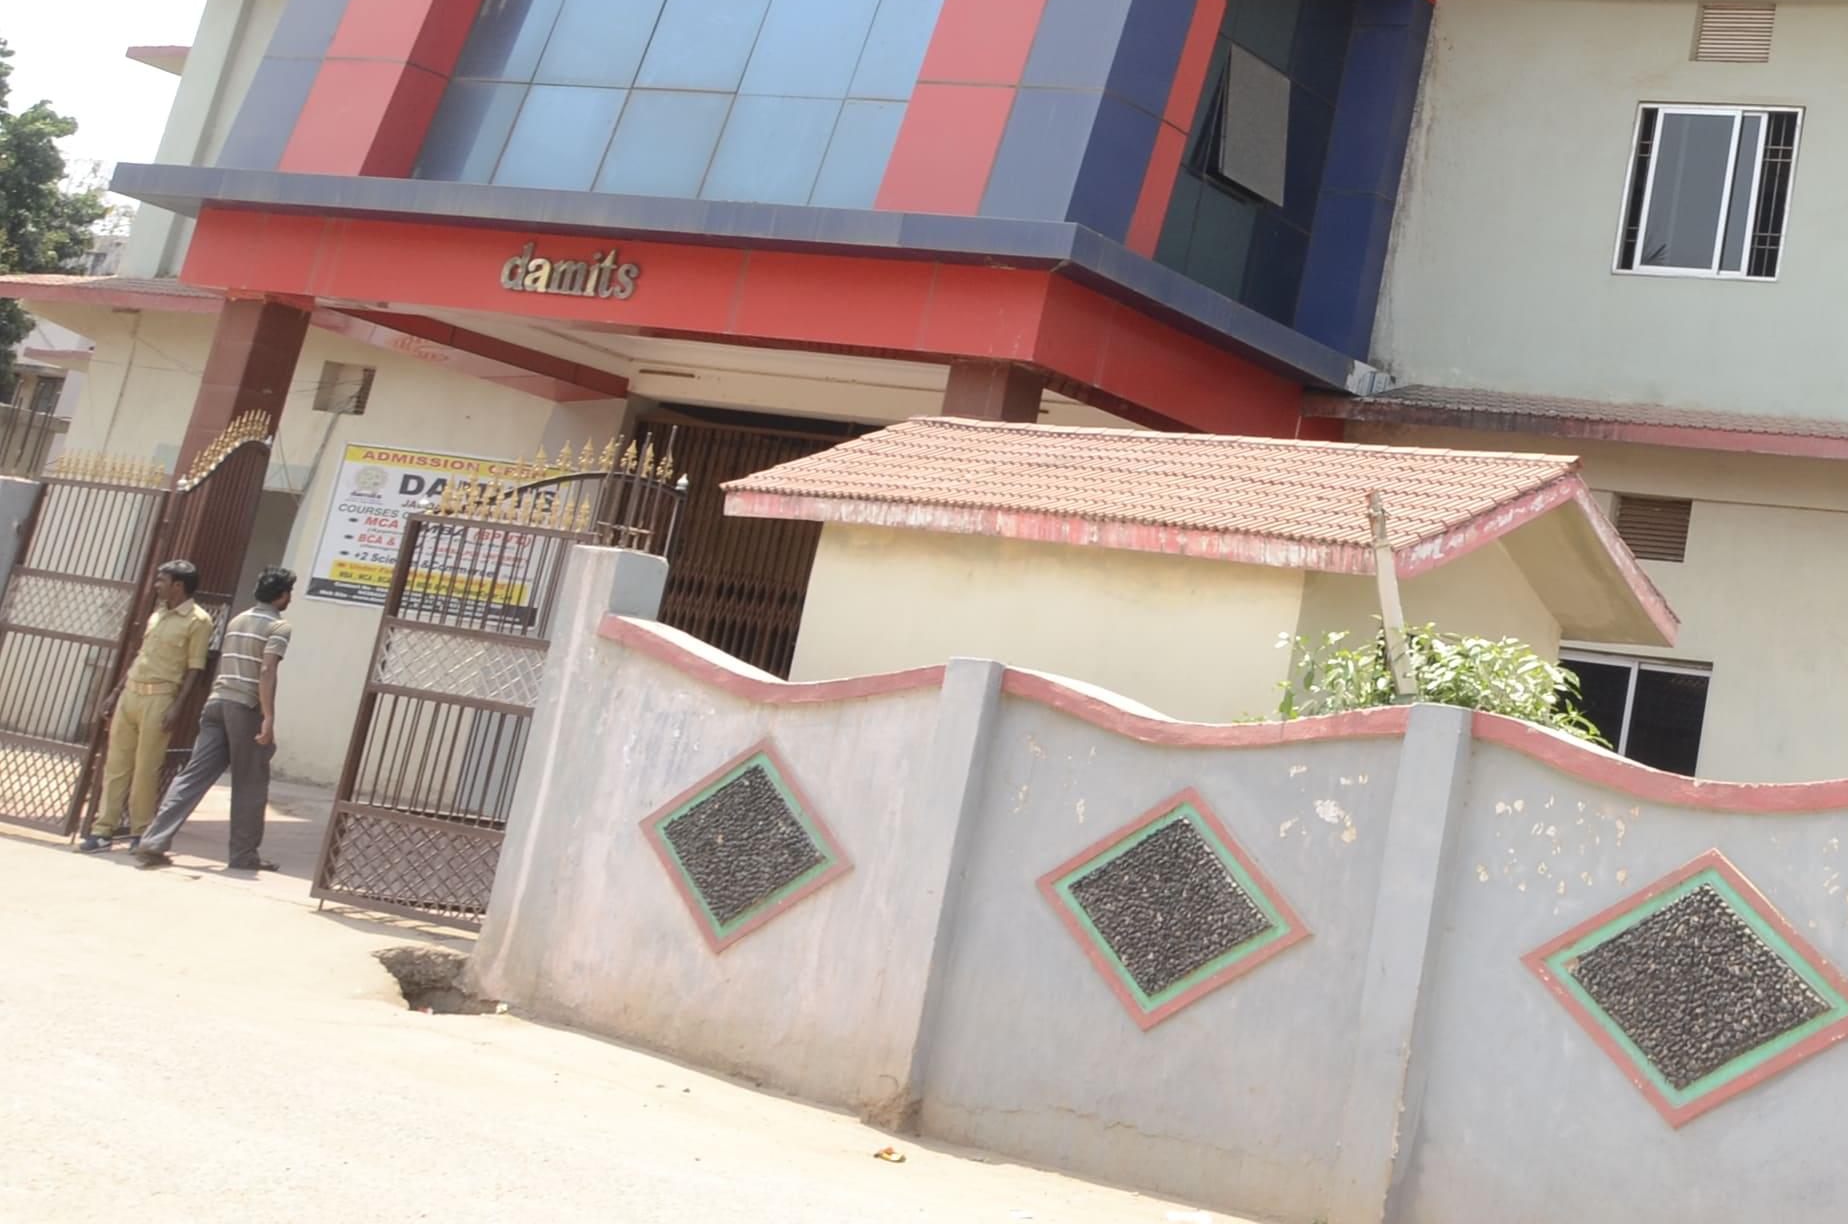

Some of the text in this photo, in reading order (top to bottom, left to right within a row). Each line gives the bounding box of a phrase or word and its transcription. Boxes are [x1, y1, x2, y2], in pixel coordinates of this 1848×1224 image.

[501, 241, 640, 300] damits
[362, 450, 480, 473] ADMISSION
[338, 503, 400, 518] COURSES
[364, 517, 399, 529] MCA
[357, 533, 383, 545] BCA
[354, 551, 369, 561] +2
